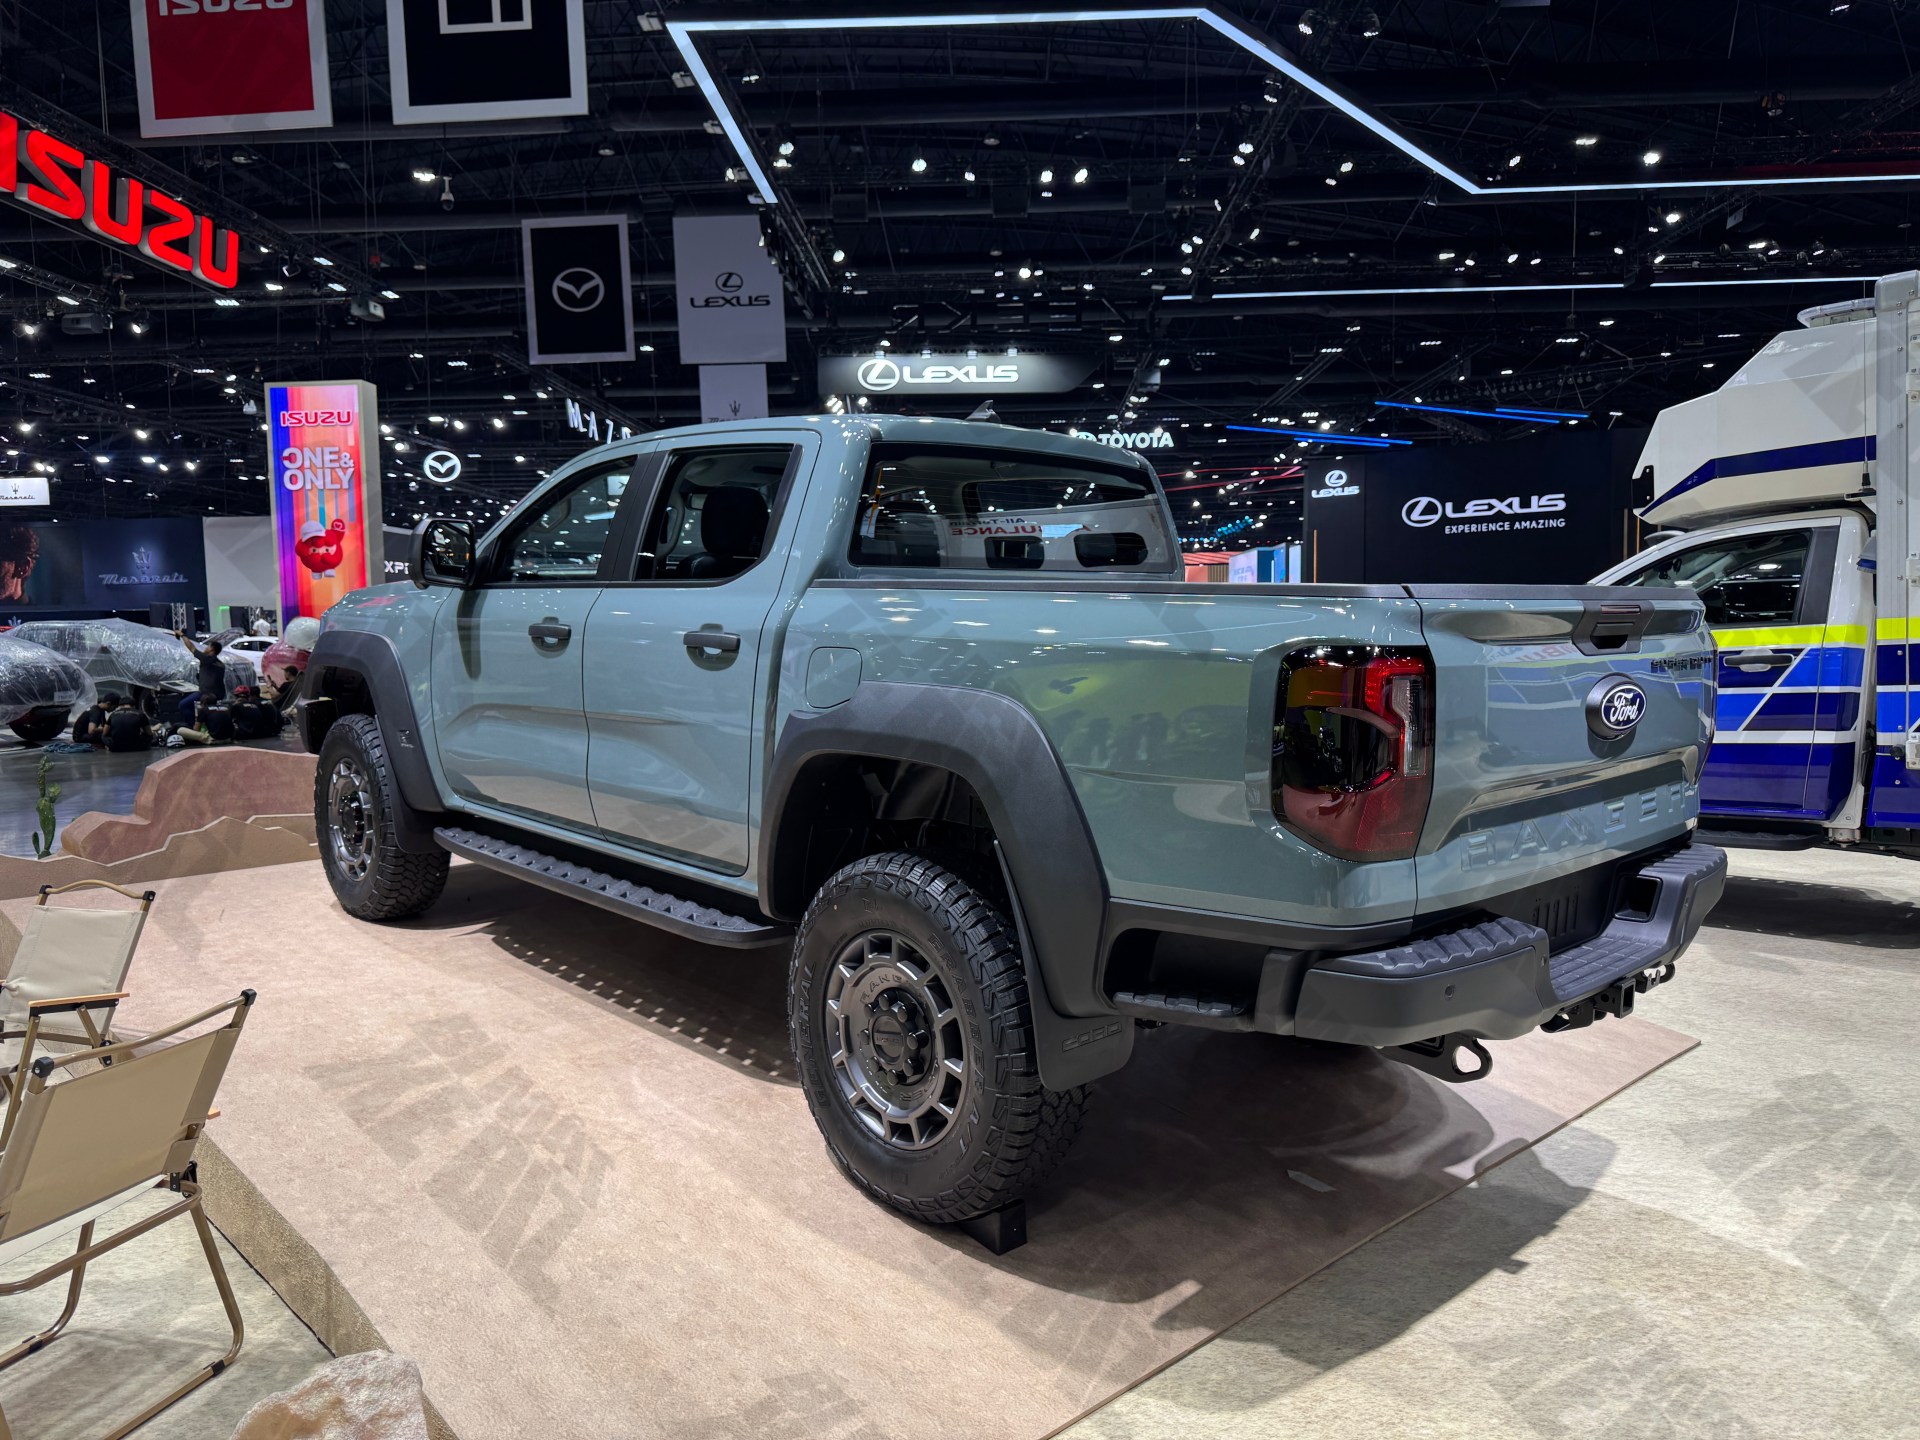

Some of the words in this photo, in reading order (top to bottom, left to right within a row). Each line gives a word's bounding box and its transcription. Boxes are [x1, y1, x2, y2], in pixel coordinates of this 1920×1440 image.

[0, 111, 239, 289] ISUZU
[690, 295, 771, 308] LEXUS
[902, 365, 1019, 383] LEXUS
[281, 410, 352, 426] ISUZU
[1097, 432, 1174, 449] TOYOTA
[283, 467, 354, 490] ONLY
[1311, 485, 1360, 498] LEXUS
[1445, 493, 1566, 518] LEXUS
[1445, 521, 1510, 534] EXPERIENCE
[1513, 518, 1566, 530] AMAZING
[98, 572, 189, 585] Maserati
[1610, 692, 1640, 722] Ford
[1459, 783, 1686, 872] RANGER
